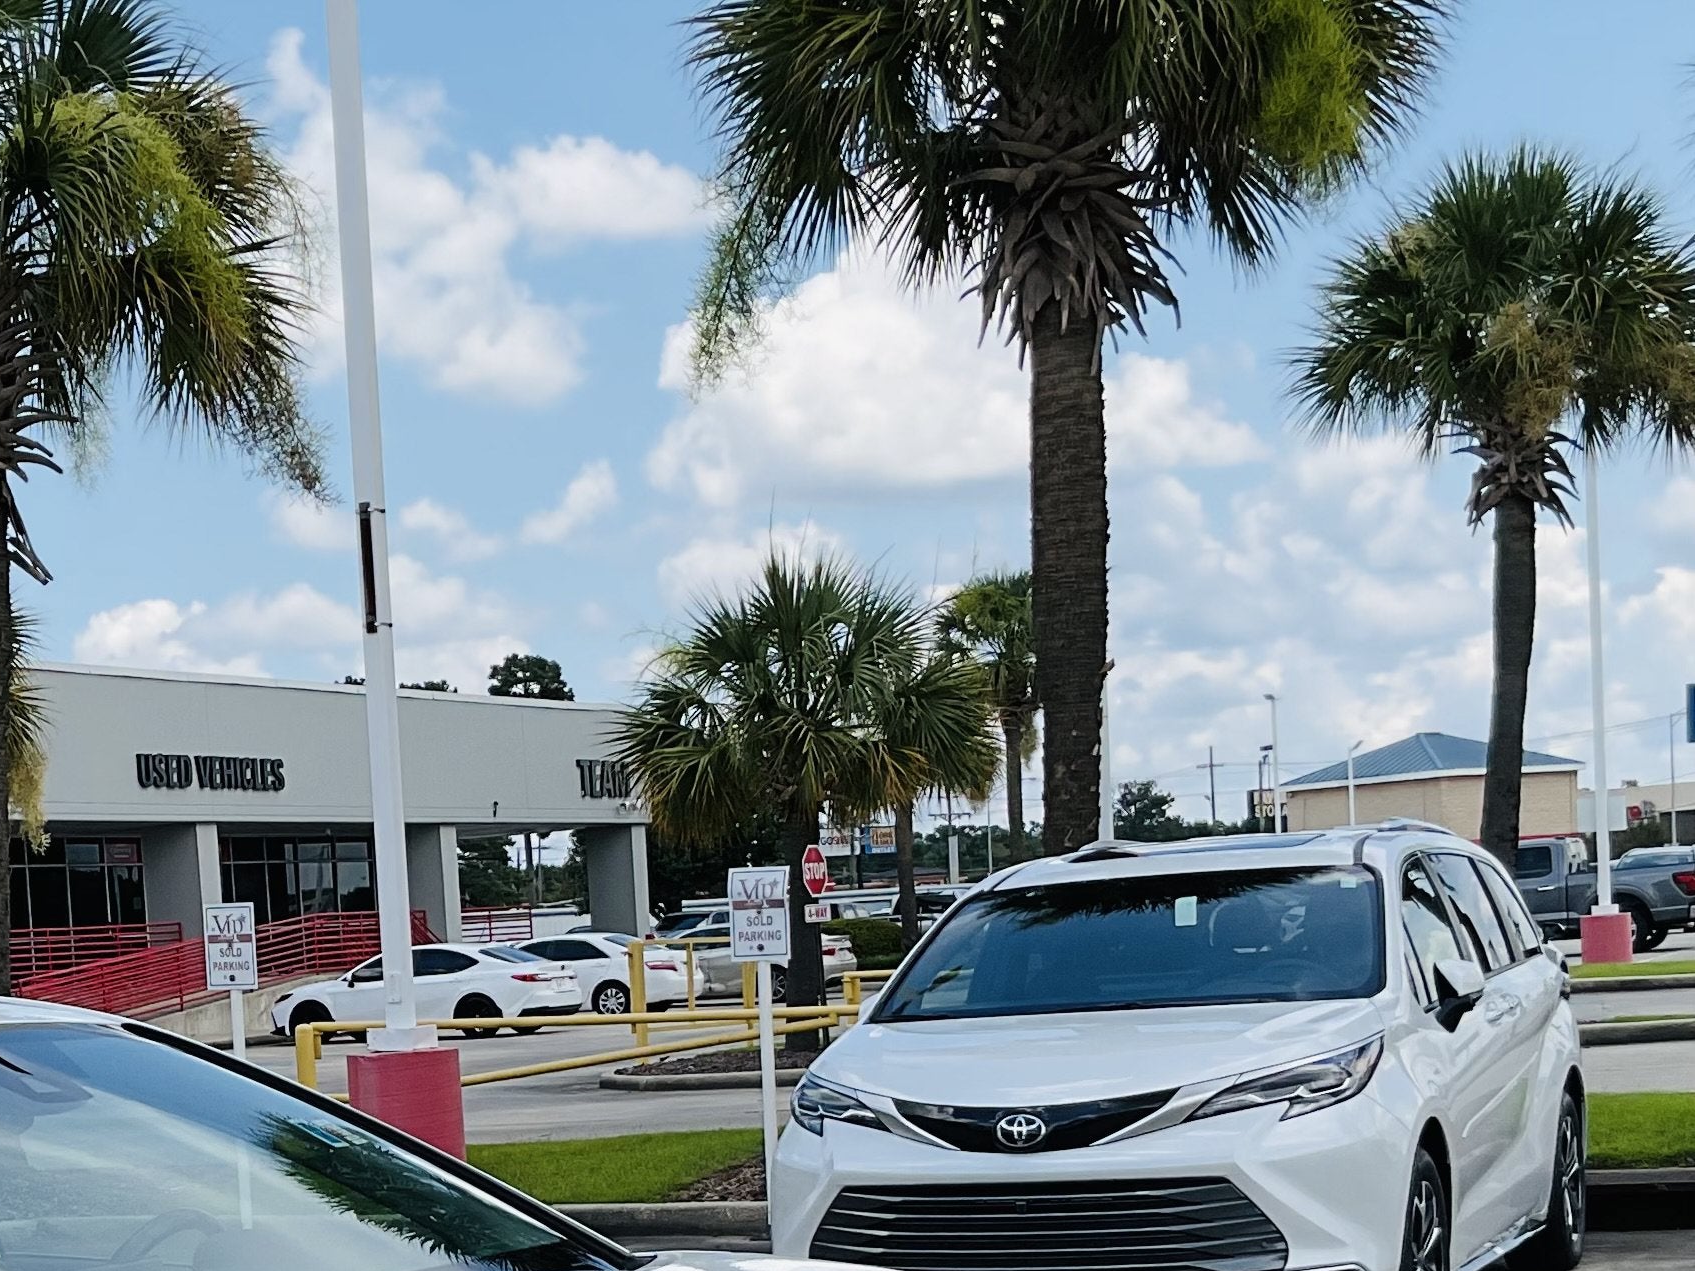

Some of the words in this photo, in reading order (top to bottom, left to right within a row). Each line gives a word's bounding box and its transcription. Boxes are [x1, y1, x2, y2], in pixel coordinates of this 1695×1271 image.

[136, 753, 192, 788] USED
[194, 756, 286, 791] VEHICLES
[575, 759, 631, 798] TEAM
[805, 862, 825, 880] STOP
[808, 907, 828, 918] 4-WAY
[746, 915, 773, 927] SOLD
[738, 930, 782, 942] PARKING
[219, 947, 242, 958] SOLD
[212, 961, 250, 972] PARKING
